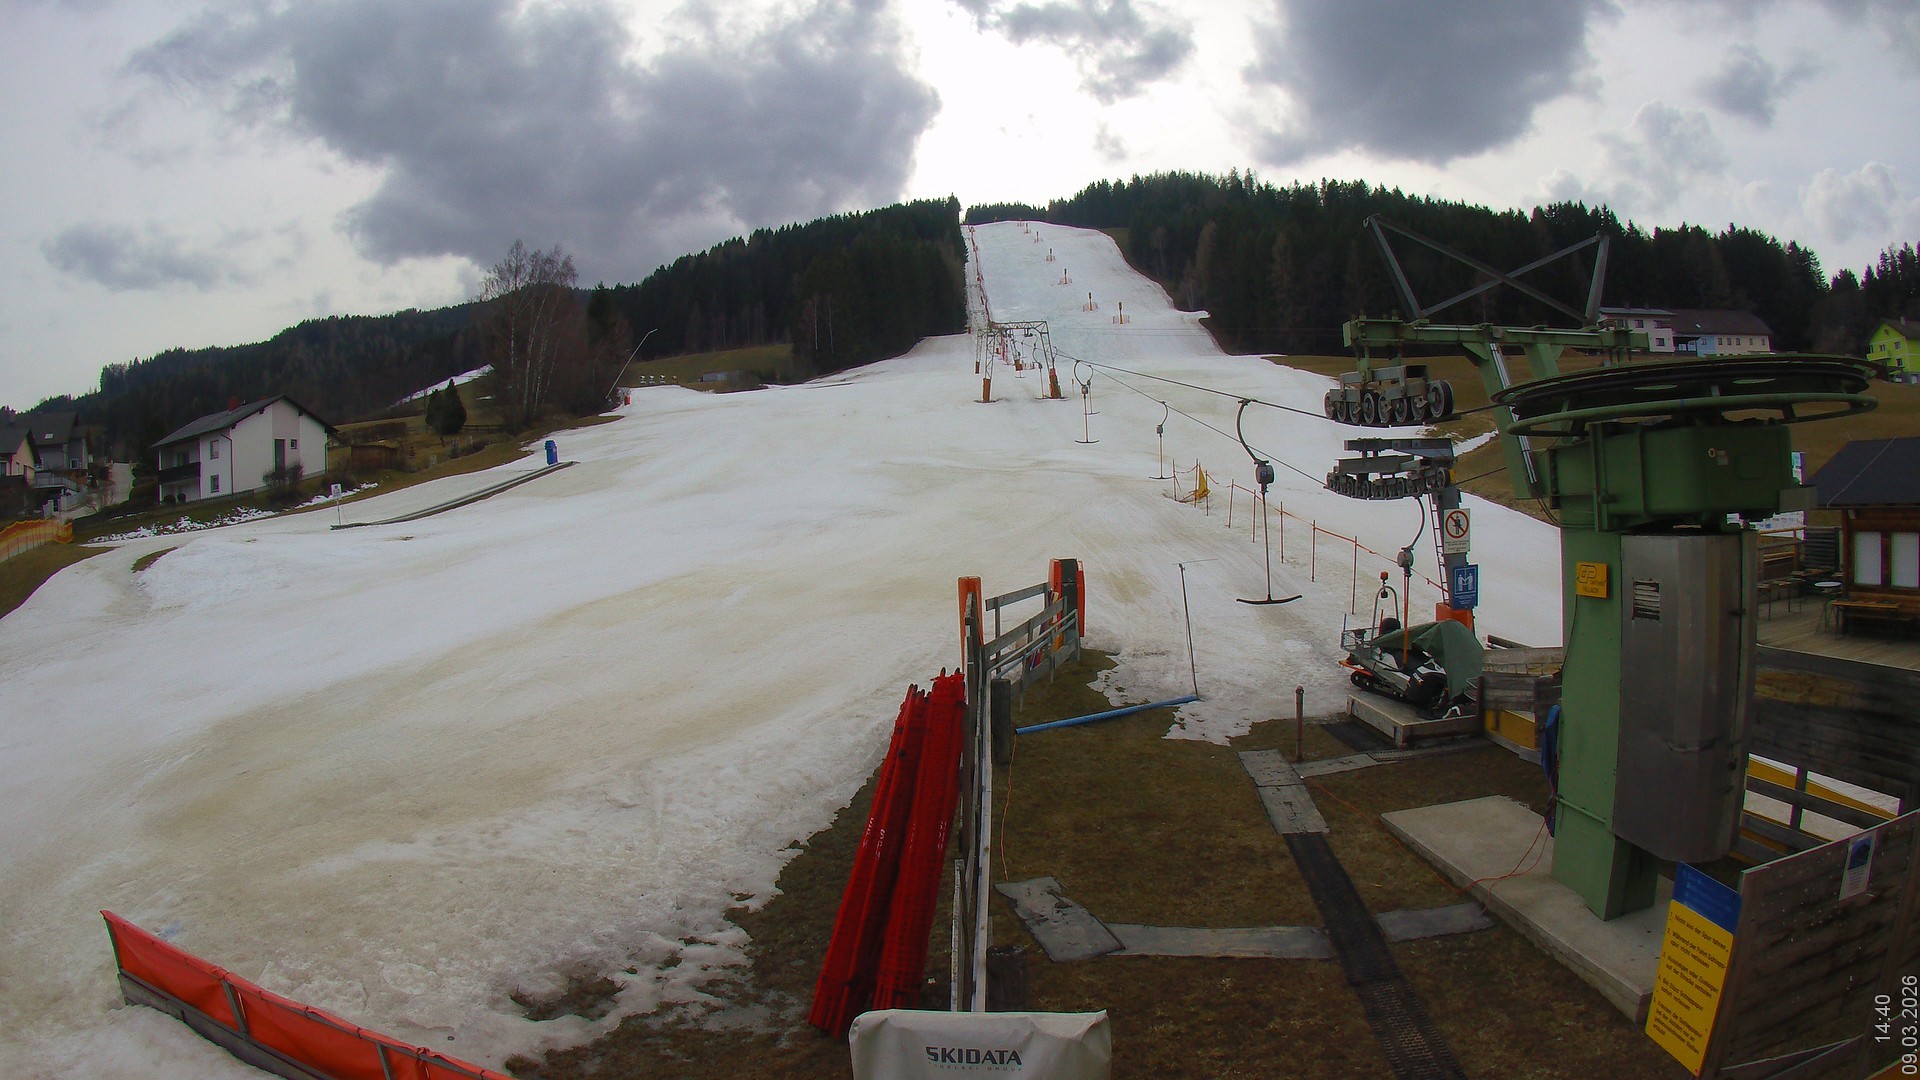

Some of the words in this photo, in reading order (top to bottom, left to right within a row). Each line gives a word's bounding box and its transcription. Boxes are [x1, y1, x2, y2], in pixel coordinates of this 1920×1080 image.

[1675, 914, 1686, 925] Nicht
[1686, 922, 1694, 931] aus
[1702, 931, 1712, 941] Spur
[1680, 945, 1691, 956] nicht
[925, 1046, 1022, 1065] SKIDATA
